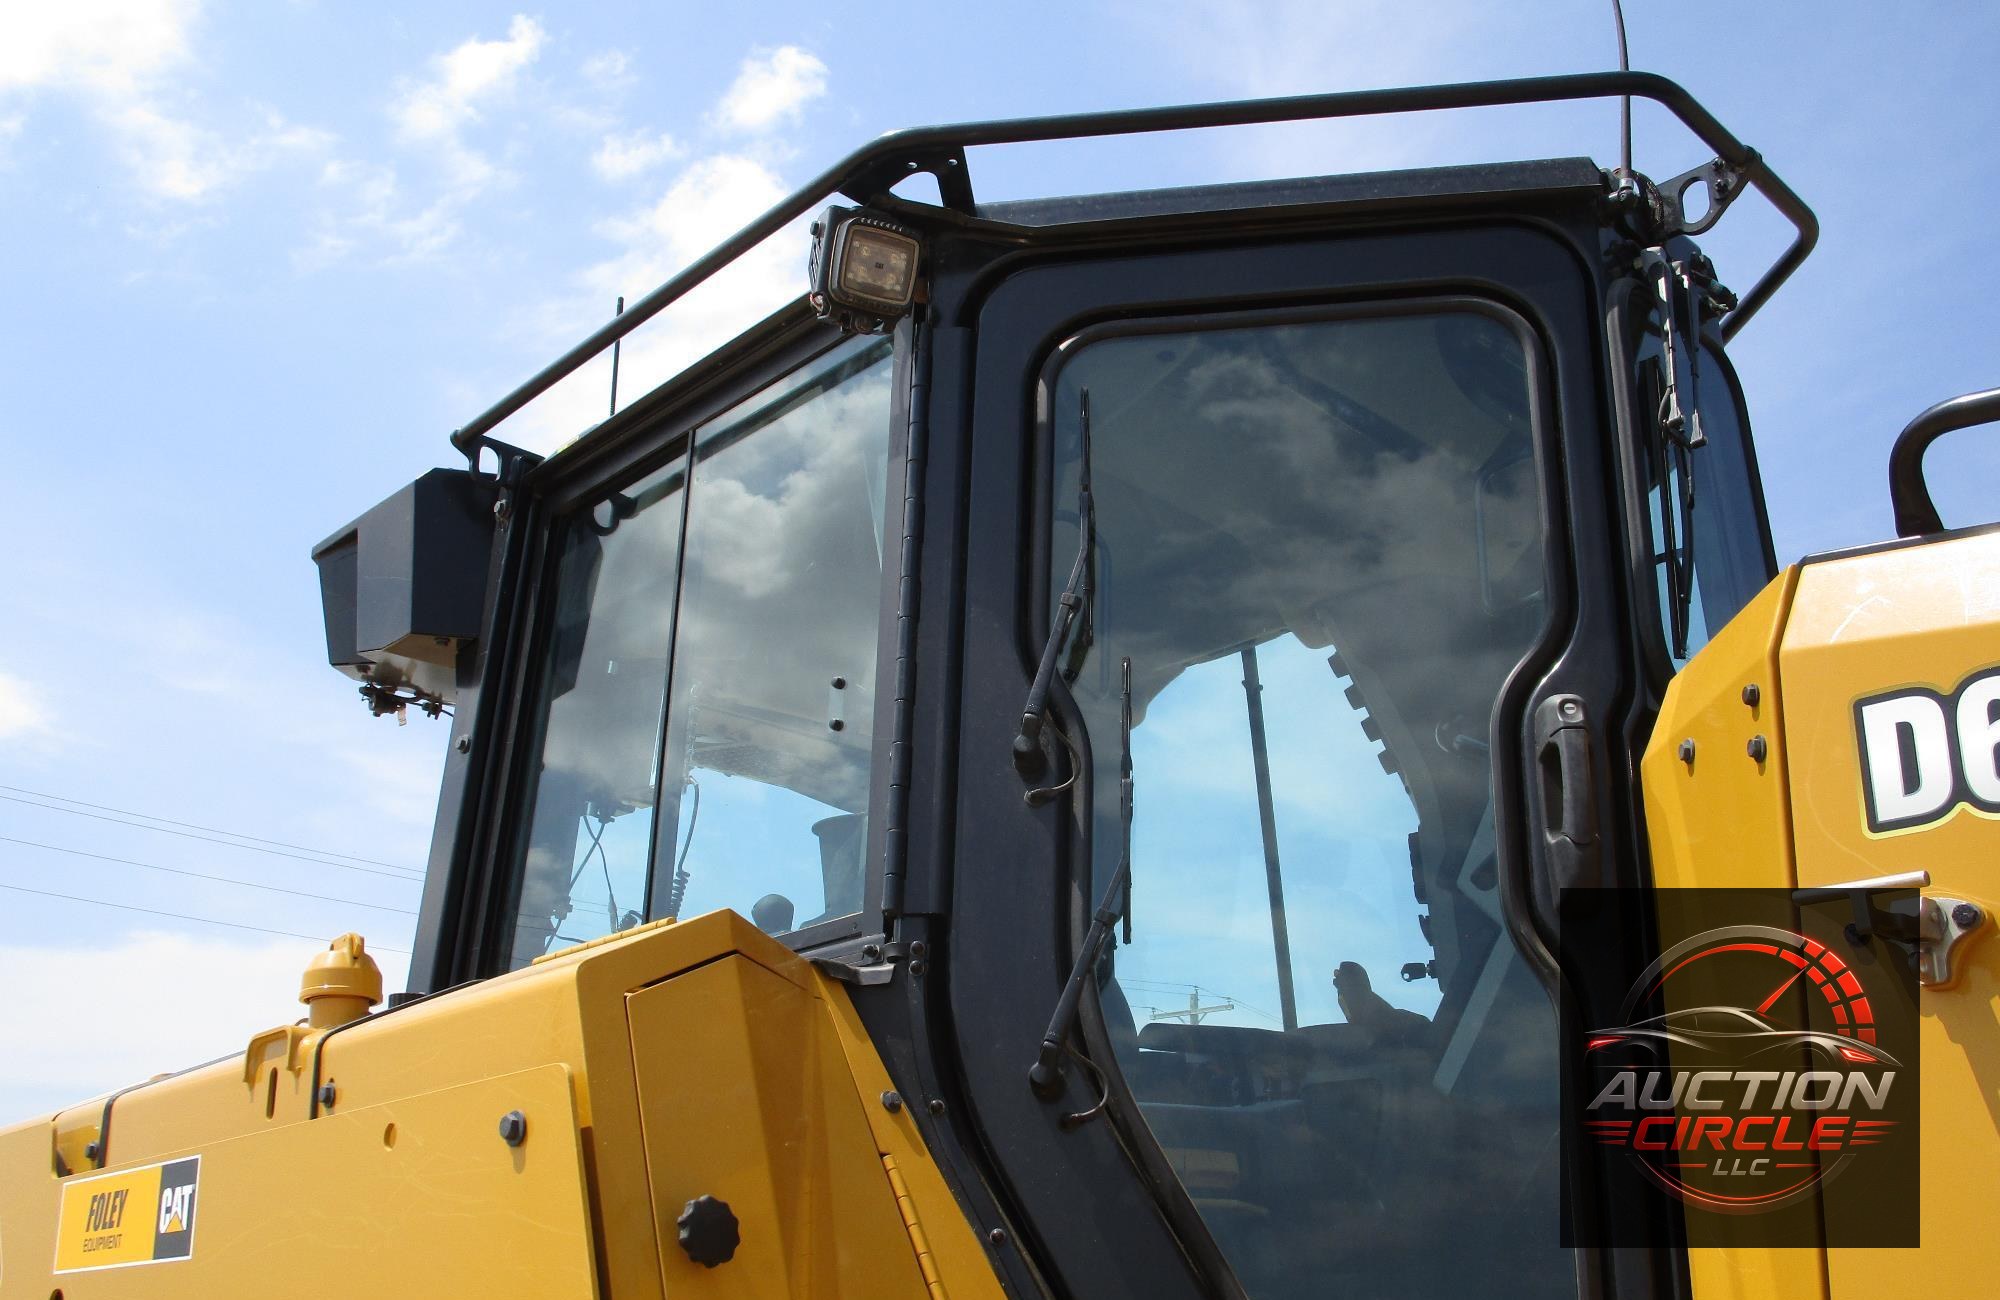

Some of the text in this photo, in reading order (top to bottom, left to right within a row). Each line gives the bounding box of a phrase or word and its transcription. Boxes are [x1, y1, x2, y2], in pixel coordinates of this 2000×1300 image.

[85, 1189, 129, 1232] FOLEY
[159, 1184, 195, 1233] CAT
[83, 1234, 122, 1252] EQUIPMENT
